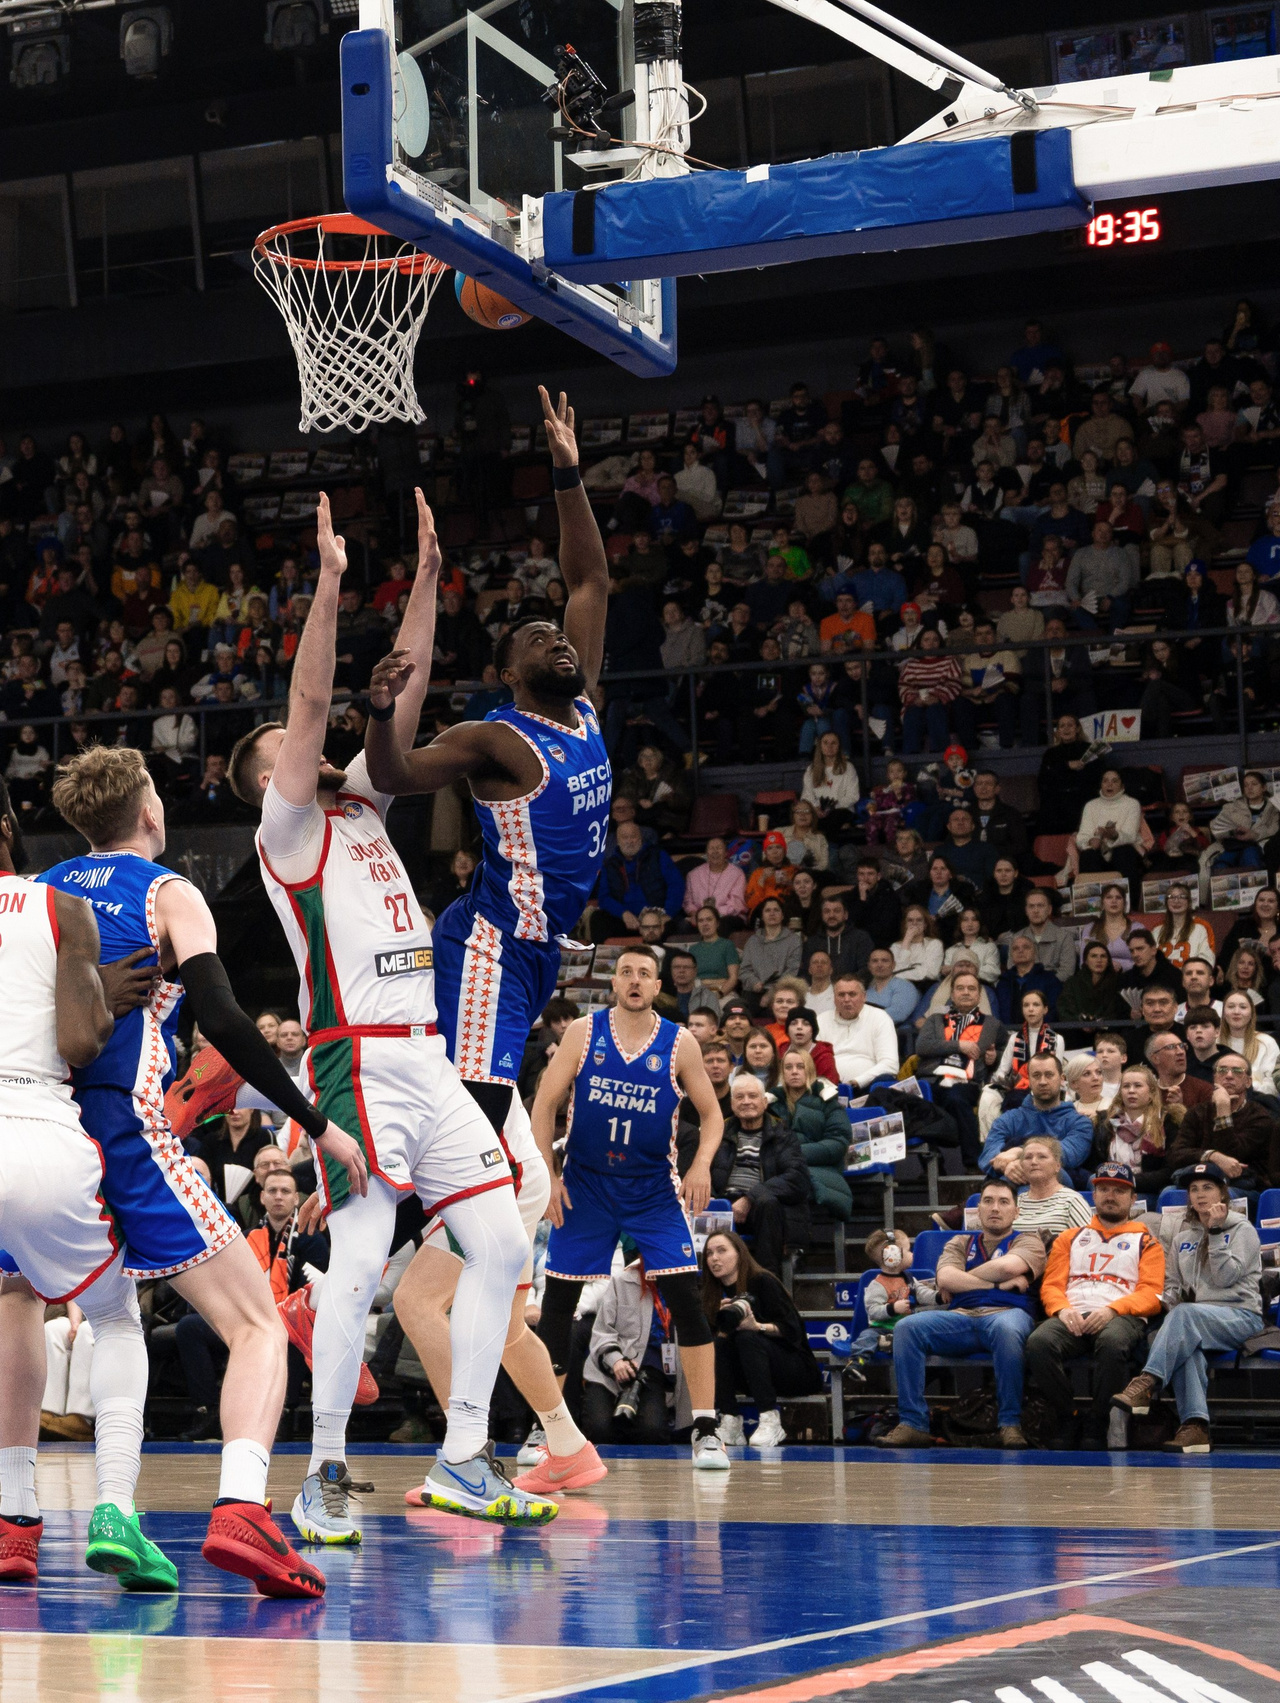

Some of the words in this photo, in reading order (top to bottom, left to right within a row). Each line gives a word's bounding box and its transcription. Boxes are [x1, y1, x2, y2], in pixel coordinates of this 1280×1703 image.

[1088, 208, 1159, 246] 19:35
[384, 893, 414, 932] 27
[589, 1074, 661, 1098] BETCITY
[588, 1088, 657, 1114] PARMA
[607, 1117, 633, 1145] 11
[1088, 1253, 1115, 1272] 17
[832, 1325, 841, 1338] 3
